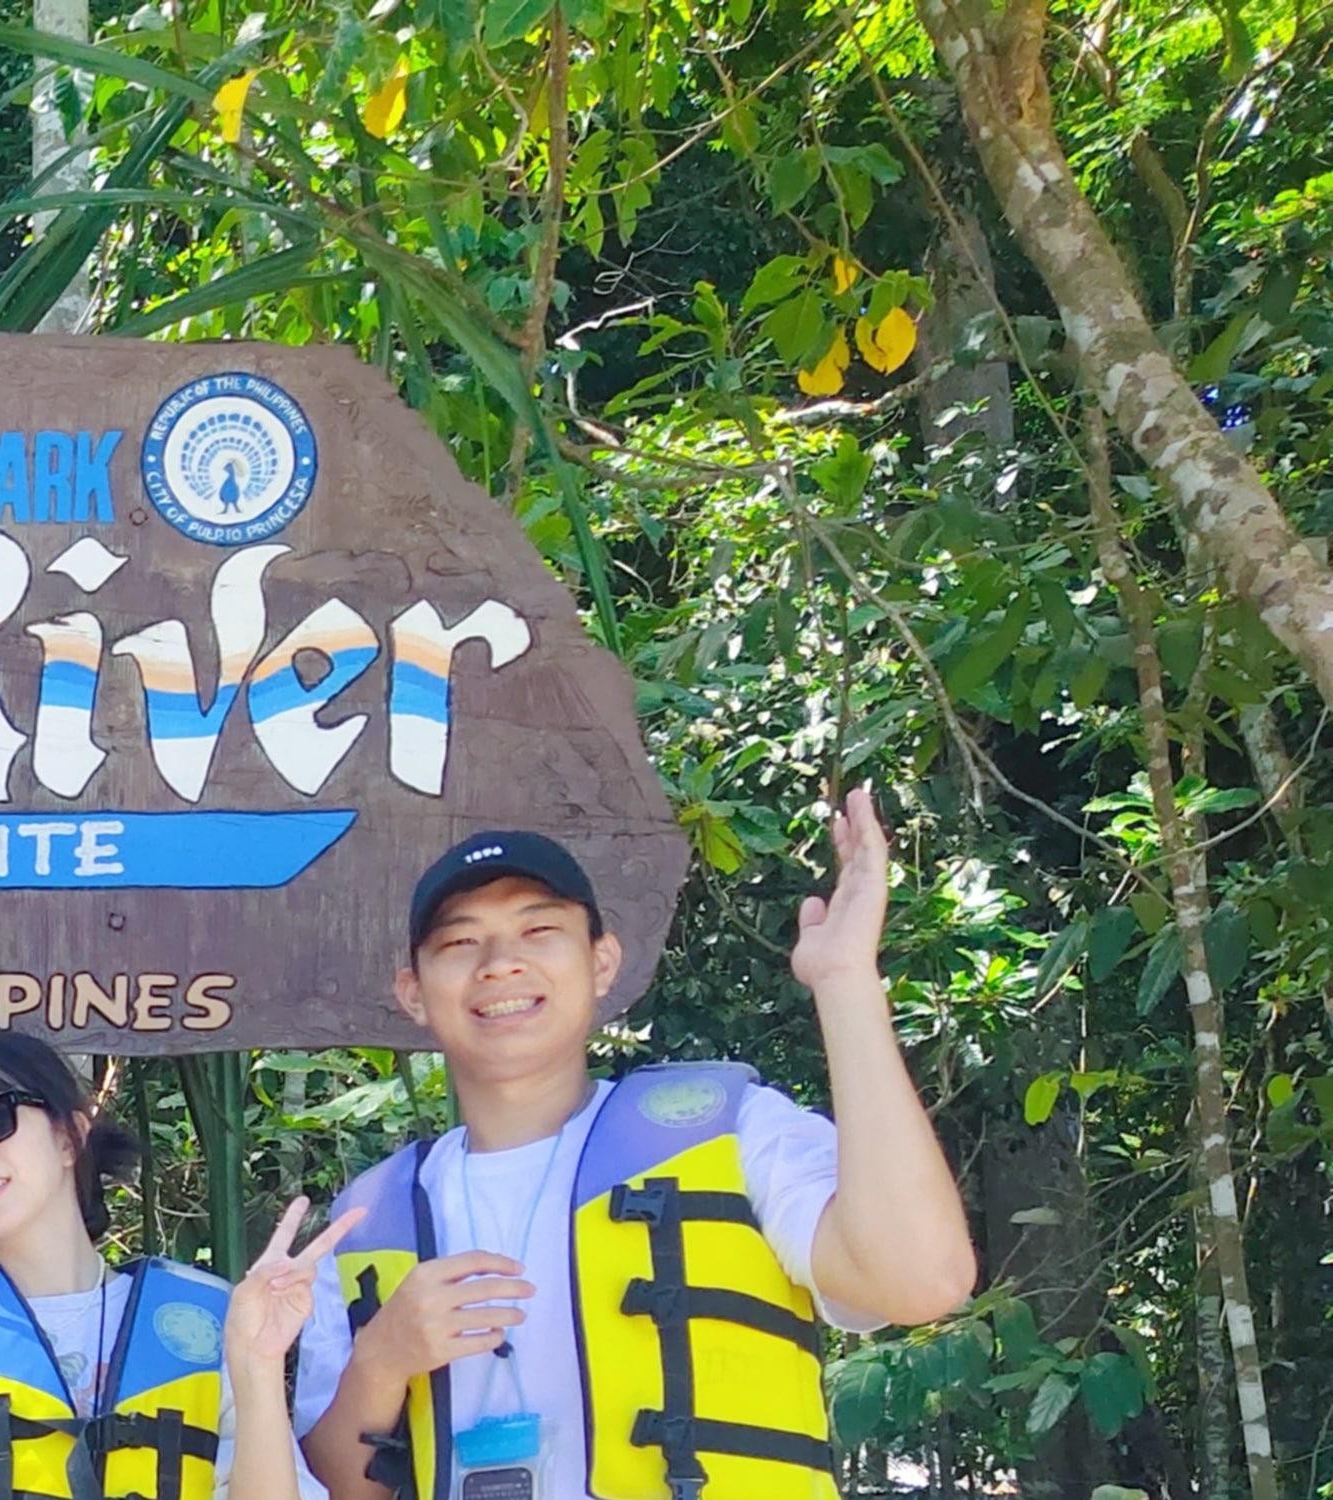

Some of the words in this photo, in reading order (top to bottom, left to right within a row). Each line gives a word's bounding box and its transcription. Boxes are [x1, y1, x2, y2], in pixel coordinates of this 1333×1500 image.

[194, 381, 211, 396] OF
[213, 376, 242, 391] THE
[245, 378, 308, 435] PHILIPPINES
[146, 470, 172, 505] CITY
[165, 506, 190, 525] OF
[245, 476, 309, 538] PRINCESA
